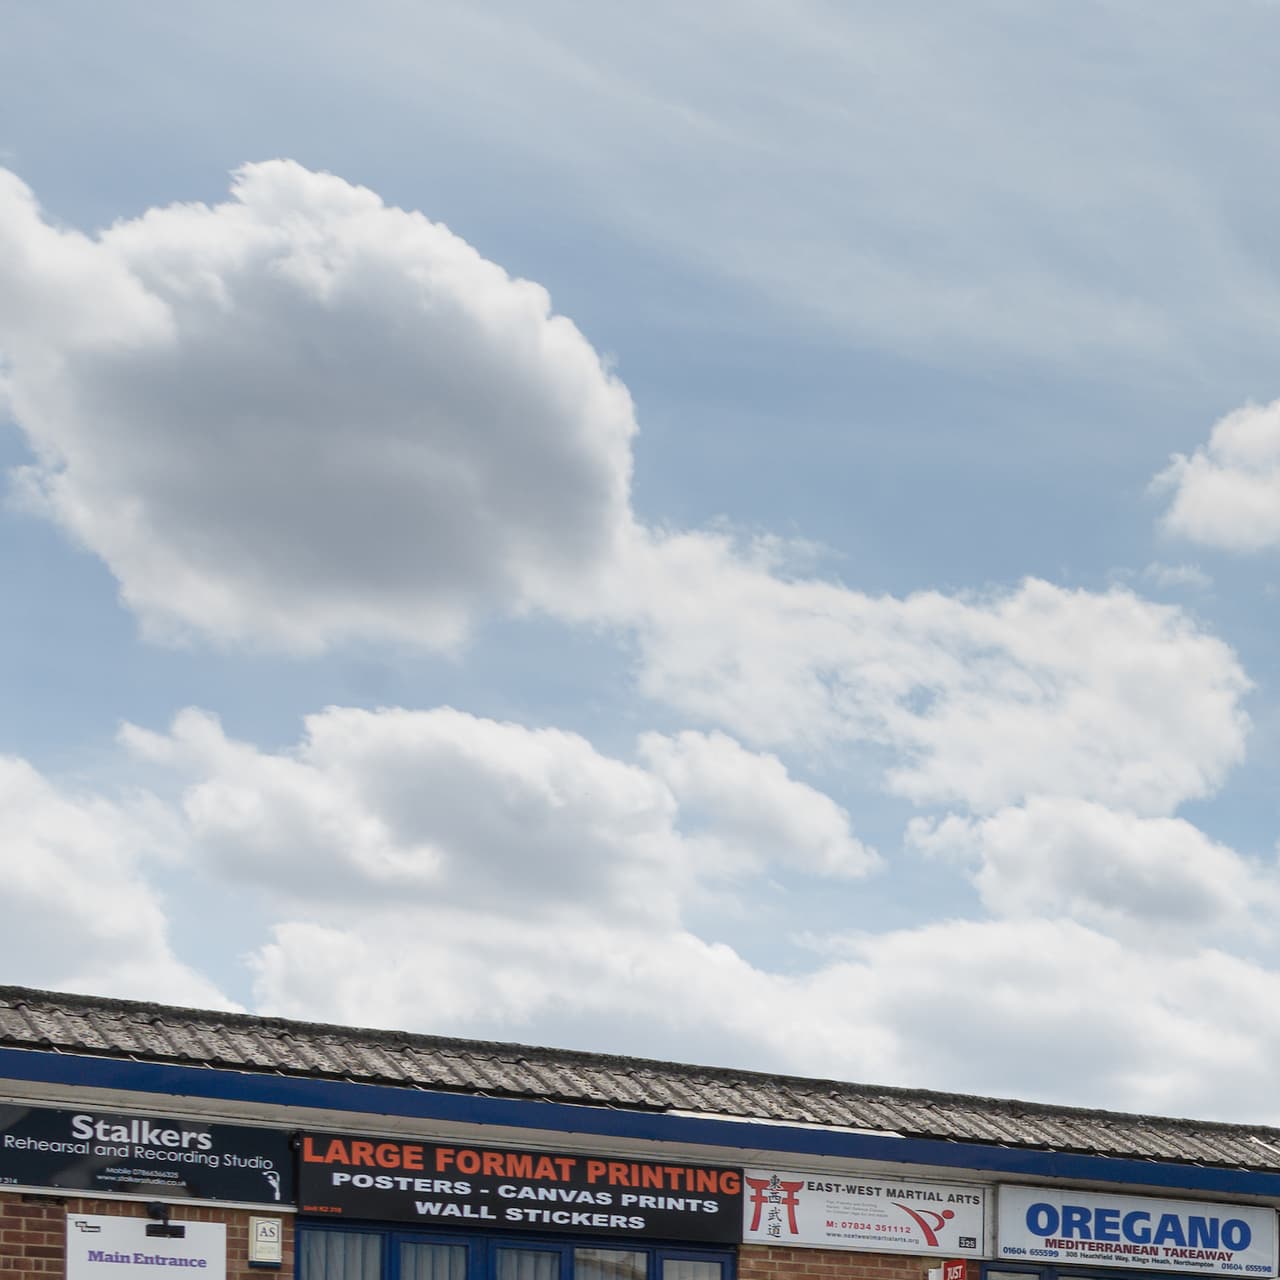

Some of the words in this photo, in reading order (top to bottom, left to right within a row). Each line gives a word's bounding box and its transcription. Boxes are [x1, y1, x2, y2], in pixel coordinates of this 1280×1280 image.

[71, 1115, 212, 1150] Stalkers
[4, 1135, 90, 1155] Rehearsal
[94, 1145, 128, 1158] and
[134, 1146, 220, 1168] Recording
[223, 1153, 274, 1170] Studio
[303, 1137, 424, 1171] LARGE
[435, 1148, 575, 1182] FORMAT
[586, 1160, 741, 1195] PRINTING
[332, 1172, 473, 1196] POSTERS
[498, 1185, 612, 1205] CANVAS
[621, 1193, 720, 1214] PRINTS
[807, 1181, 882, 1197] EAST-WEST
[886, 1188, 943, 1202] MARTIAL
[948, 1194, 980, 1205] ARTS
[415, 1201, 496, 1220] WALL
[505, 1208, 646, 1230] STICKERS
[767, 1174, 783, 1238] 東西武道
[259, 1226, 276, 1239] AS
[826, 1220, 839, 1228] M:
[841, 1221, 871, 1231] 07834
[875, 1224, 911, 1233] 351112
[1026, 1202, 1252, 1251] OREGANO
[88, 1250, 130, 1265] Main
[133, 1252, 207, 1268] Entrance
[1003, 1246, 1027, 1255] 01604
[1029, 1248, 1059, 1258] 655599
[1045, 1239, 1159, 1257] MEDITERRANEAN
[1164, 1247, 1233, 1262] TAKEAWAY
[1080, 1252, 1113, 1261] Heathfield
[1132, 1256, 1149, 1264] Kings
[1174, 1259, 1214, 1268] Northampton
[947, 1265, 963, 1280] JUST
[1221, 1263, 1243, 1271] 01604
